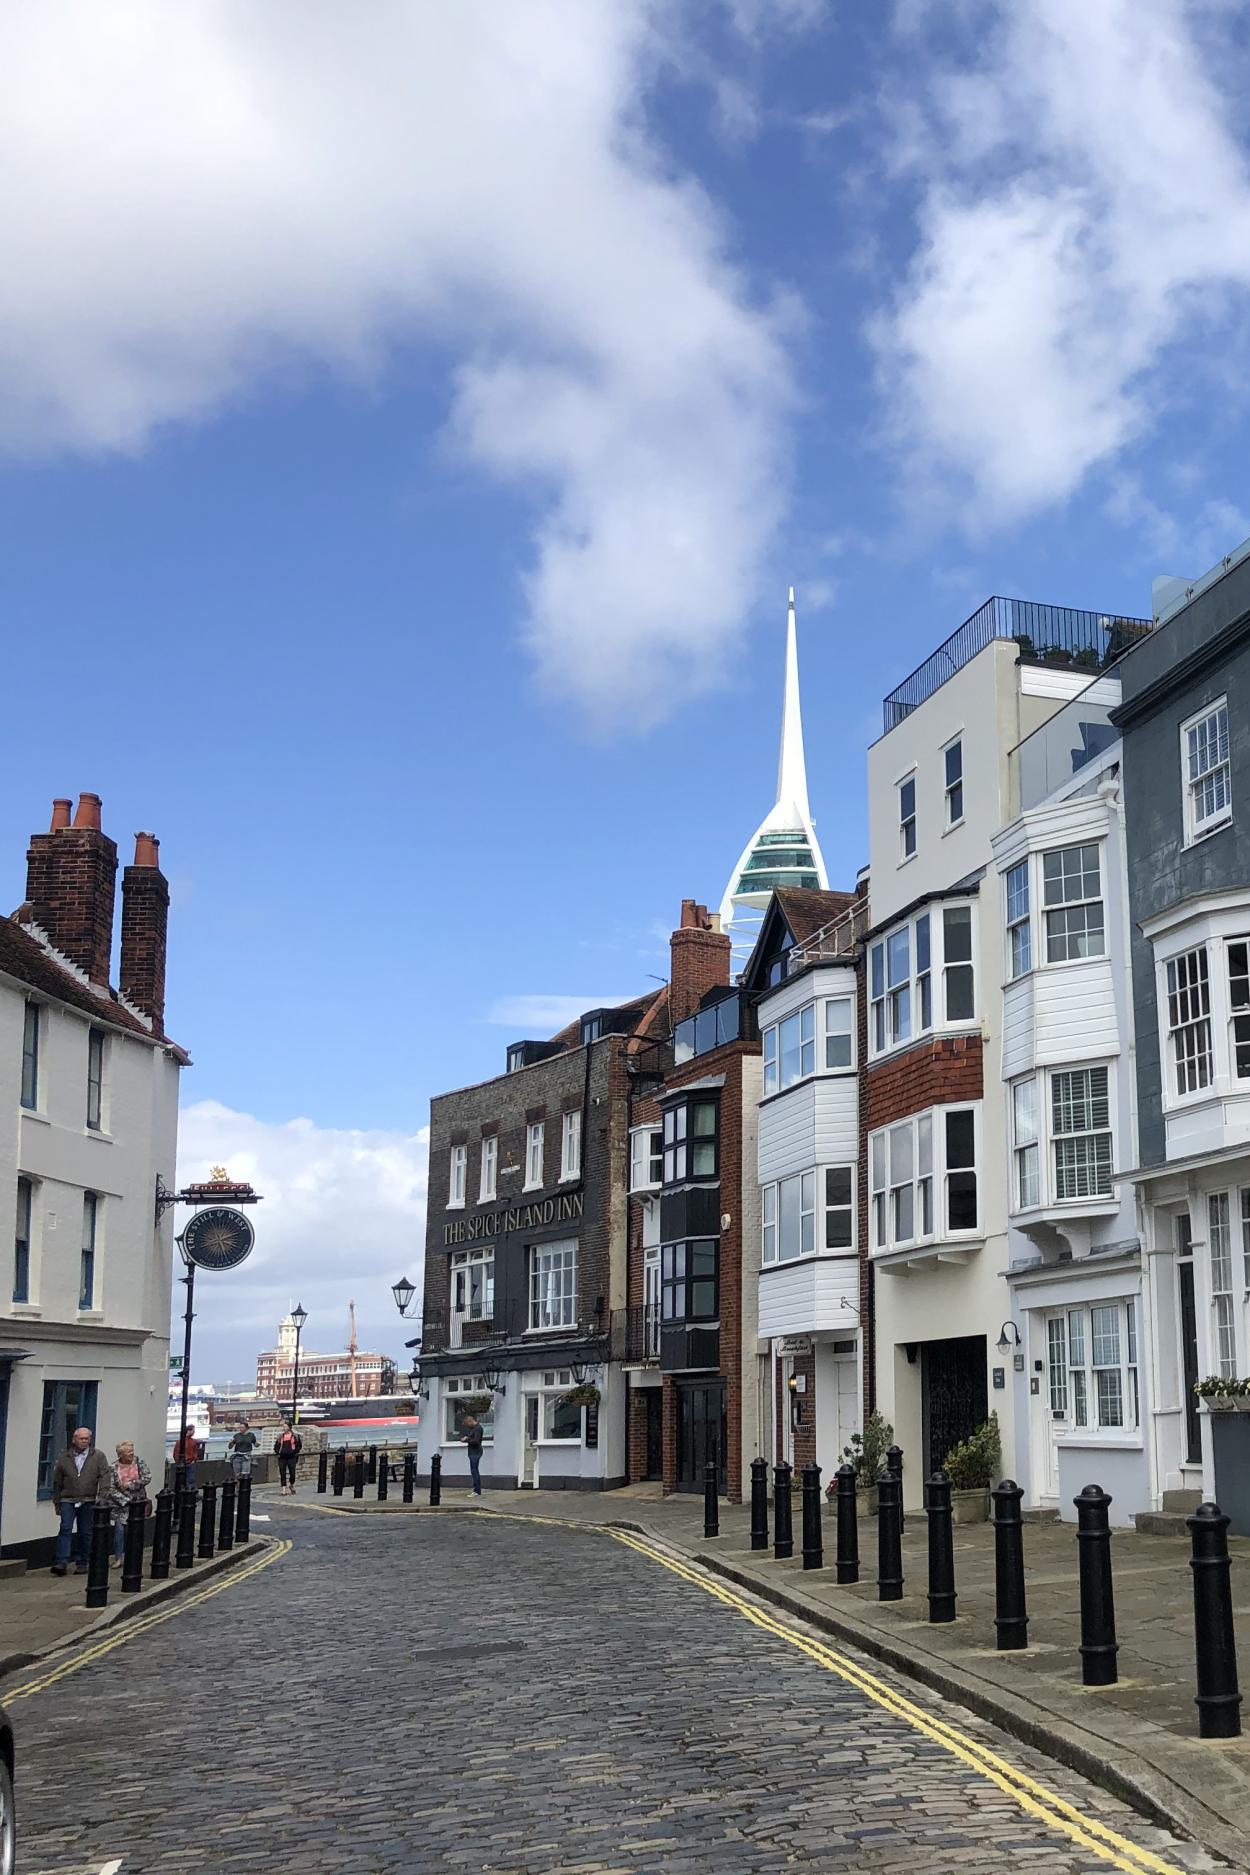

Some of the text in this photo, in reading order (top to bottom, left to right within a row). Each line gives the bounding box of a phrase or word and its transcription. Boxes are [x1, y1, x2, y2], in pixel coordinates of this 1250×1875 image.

[191, 1212, 215, 1230] STILL
[228, 1212, 249, 1231] WEST
[443, 1193, 584, 1245] THE SPICE ISLAND INN
[187, 1232, 196, 1250] THE
